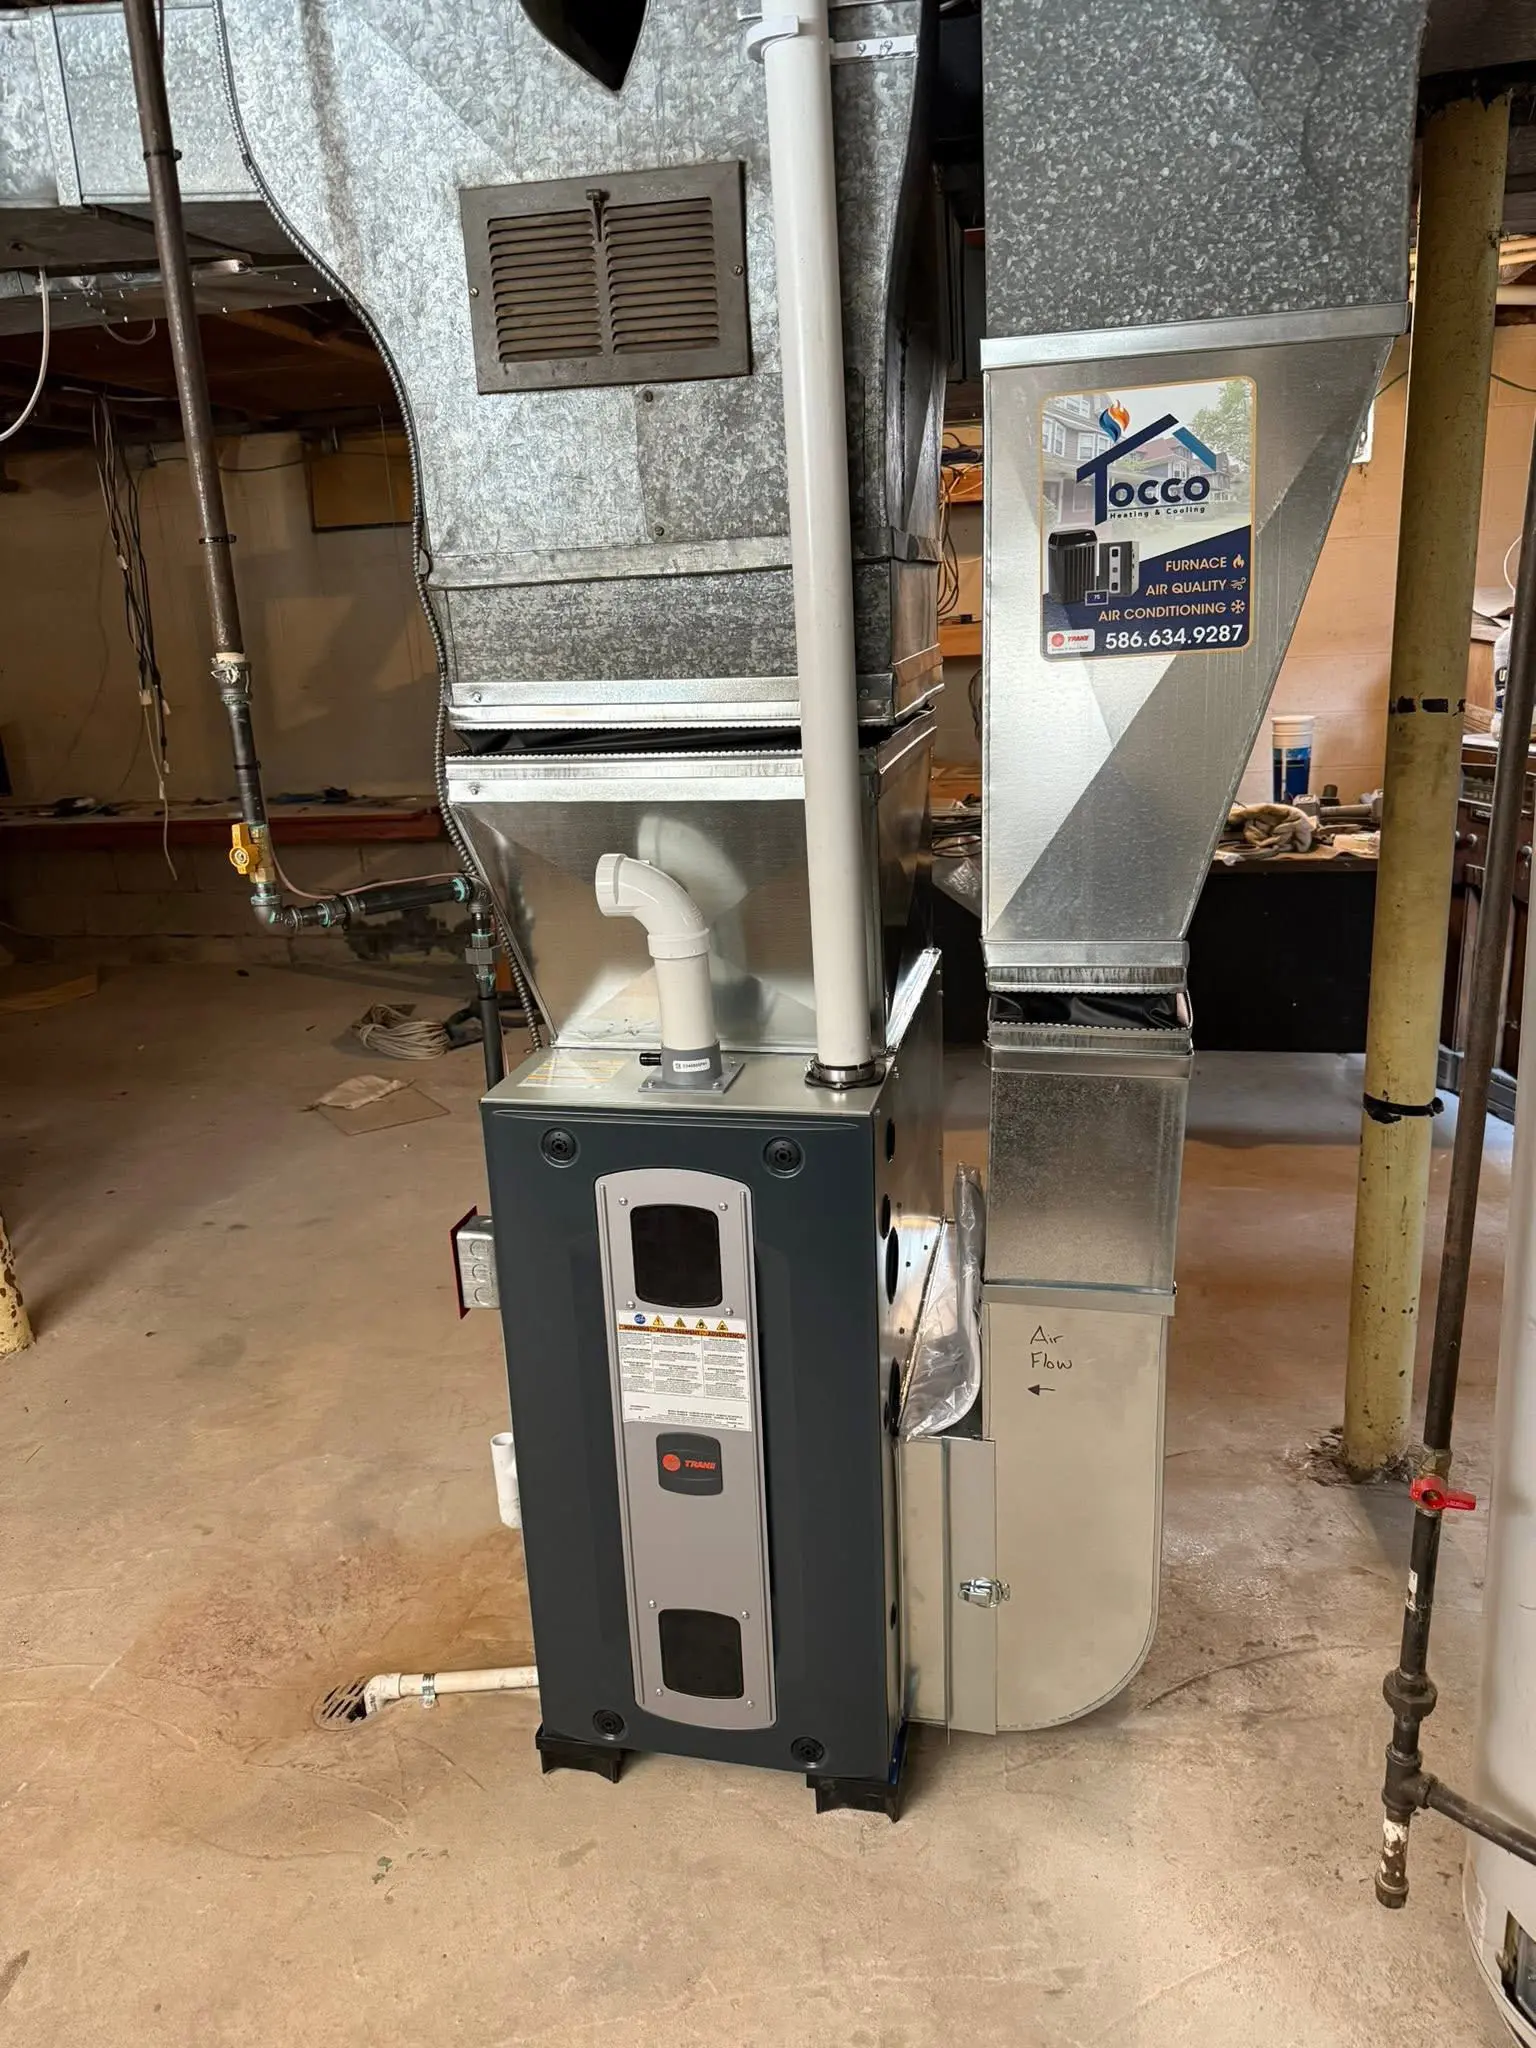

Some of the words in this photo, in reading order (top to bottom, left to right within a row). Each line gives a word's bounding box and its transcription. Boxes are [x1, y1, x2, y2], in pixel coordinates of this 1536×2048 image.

[1110, 511, 1149, 519] Heating
[1166, 506, 1206, 514] Cooling
[1165, 557, 1227, 572] FURNACE
[1145, 584, 1168, 596] AIR
[1171, 580, 1227, 594] QUALITY
[1098, 610, 1121, 621] AIR
[1124, 602, 1227, 619] CONDITIONING
[1105, 624, 1243, 649] 586.634.9287
[1029, 1324, 1064, 1345] Air
[1030, 1351, 1073, 1370] Flow
